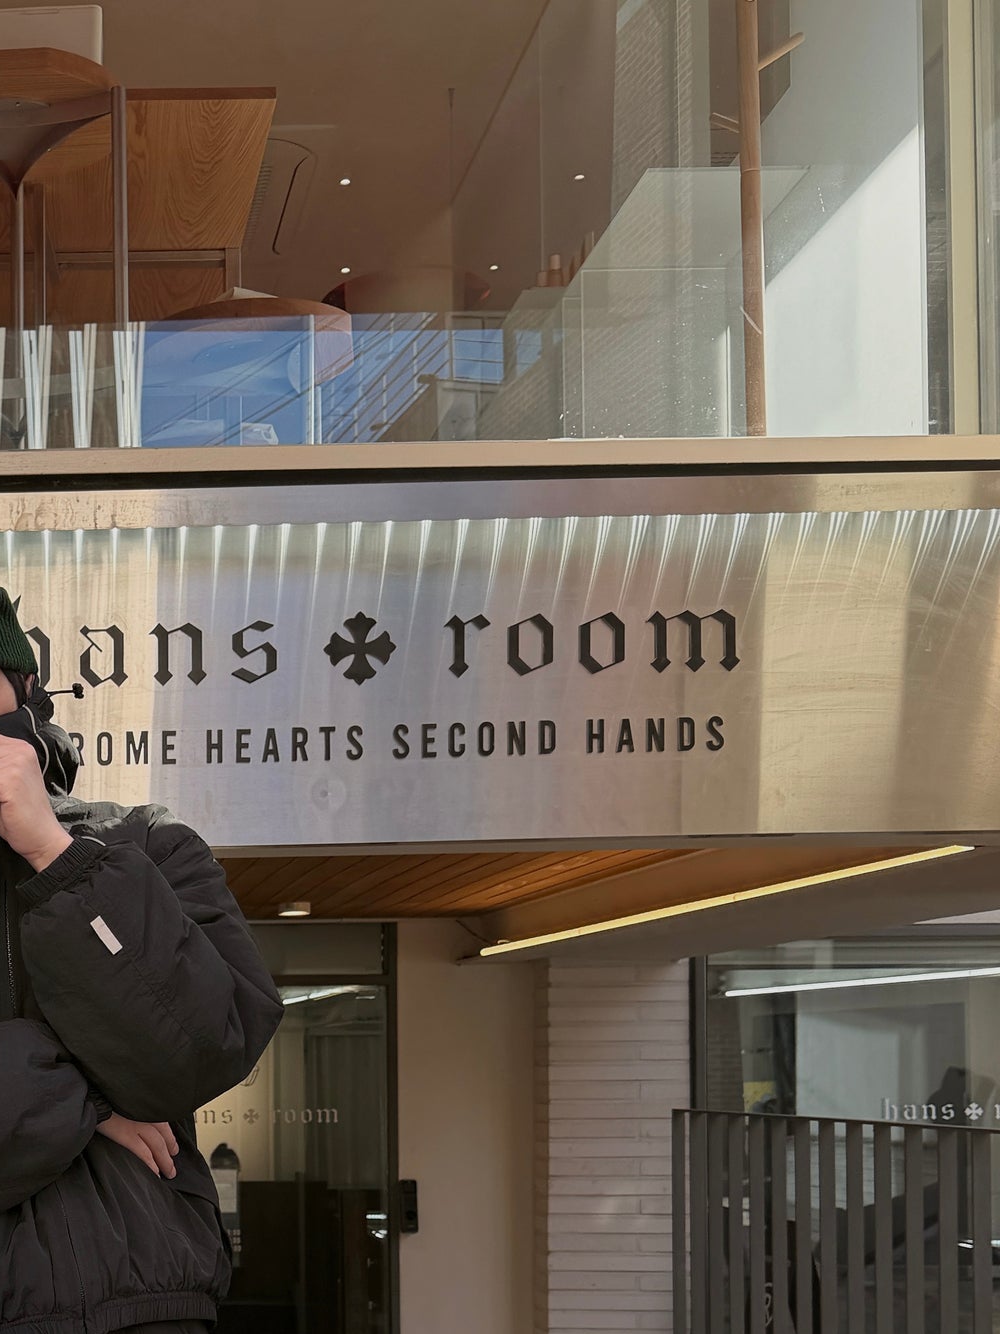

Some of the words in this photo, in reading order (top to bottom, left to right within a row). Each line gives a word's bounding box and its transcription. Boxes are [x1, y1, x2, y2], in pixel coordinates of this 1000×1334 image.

[443, 608, 741, 678] room
[68, 730, 177, 766] ROME
[206, 725, 364, 764] HEARTS
[392, 720, 556, 760] SECOND
[586, 715, 725, 754] HANDS
[272, 1107, 339, 1124] room
[881, 1097, 955, 1121] hans
